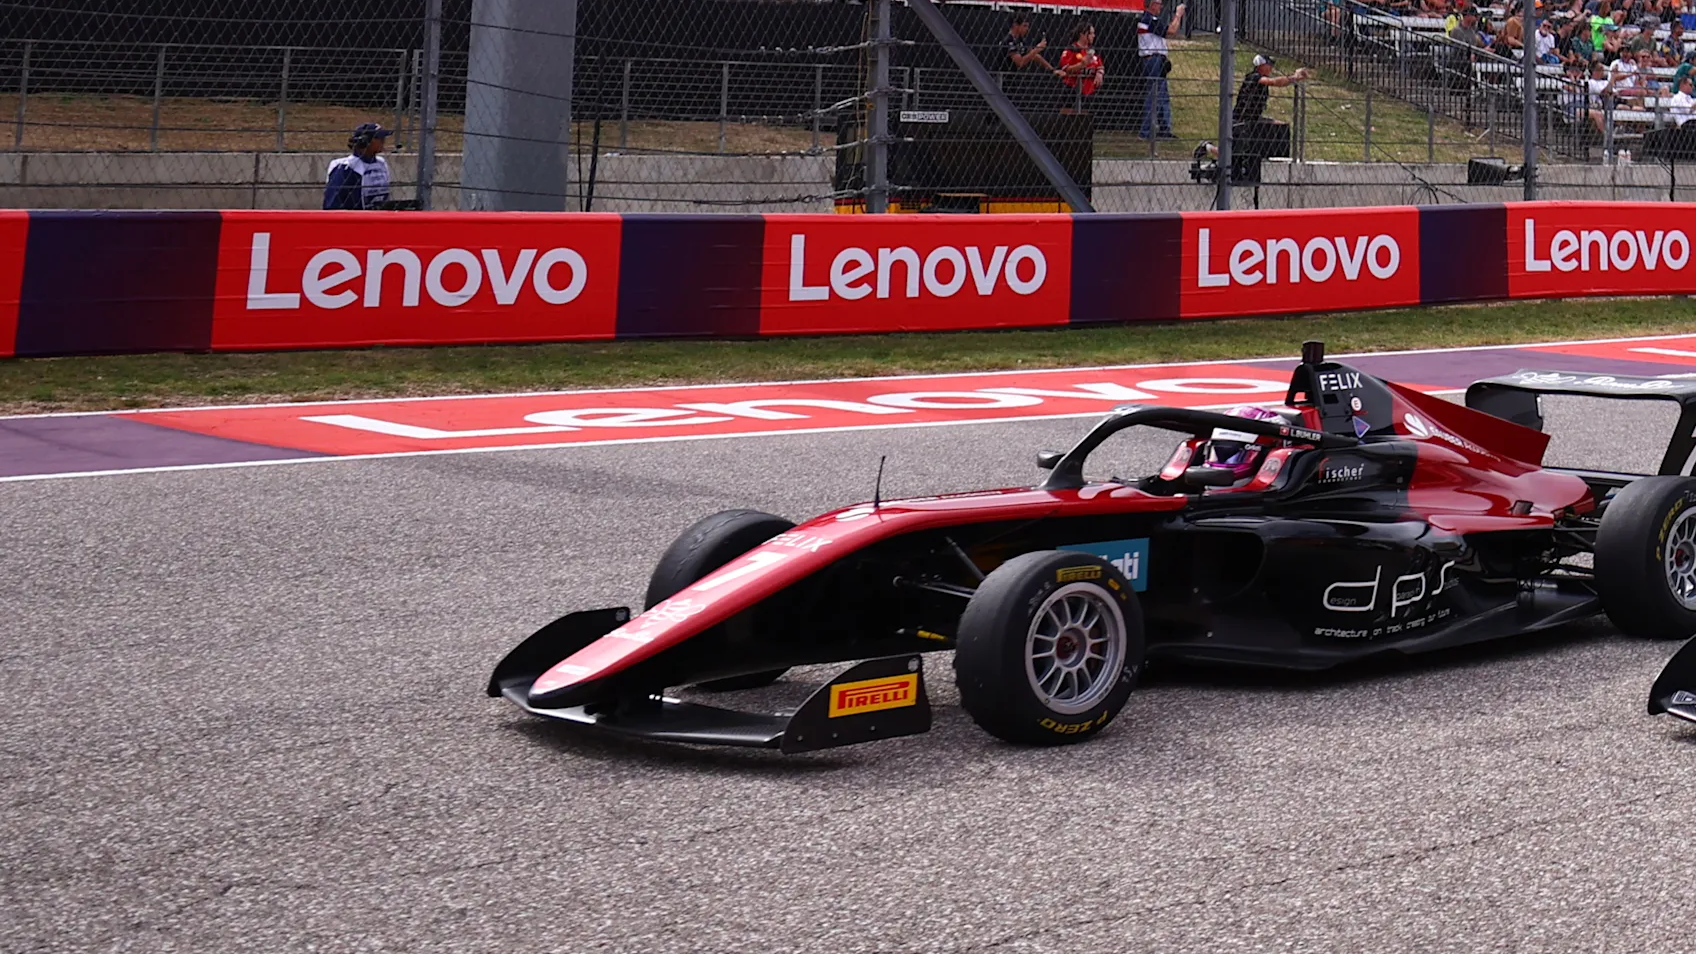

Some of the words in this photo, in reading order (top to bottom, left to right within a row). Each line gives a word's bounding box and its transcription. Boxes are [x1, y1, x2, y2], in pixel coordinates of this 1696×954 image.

[247, 232, 587, 310] Lenovo
[789, 234, 1047, 301] Lenovo
[1198, 228, 1400, 287] Lenovo
[1525, 218, 1690, 272] Lenovo
[300, 377, 1288, 440] Lenovo
[1319, 372, 1363, 391] FELIX
[837, 680, 911, 711] PIRELLI
